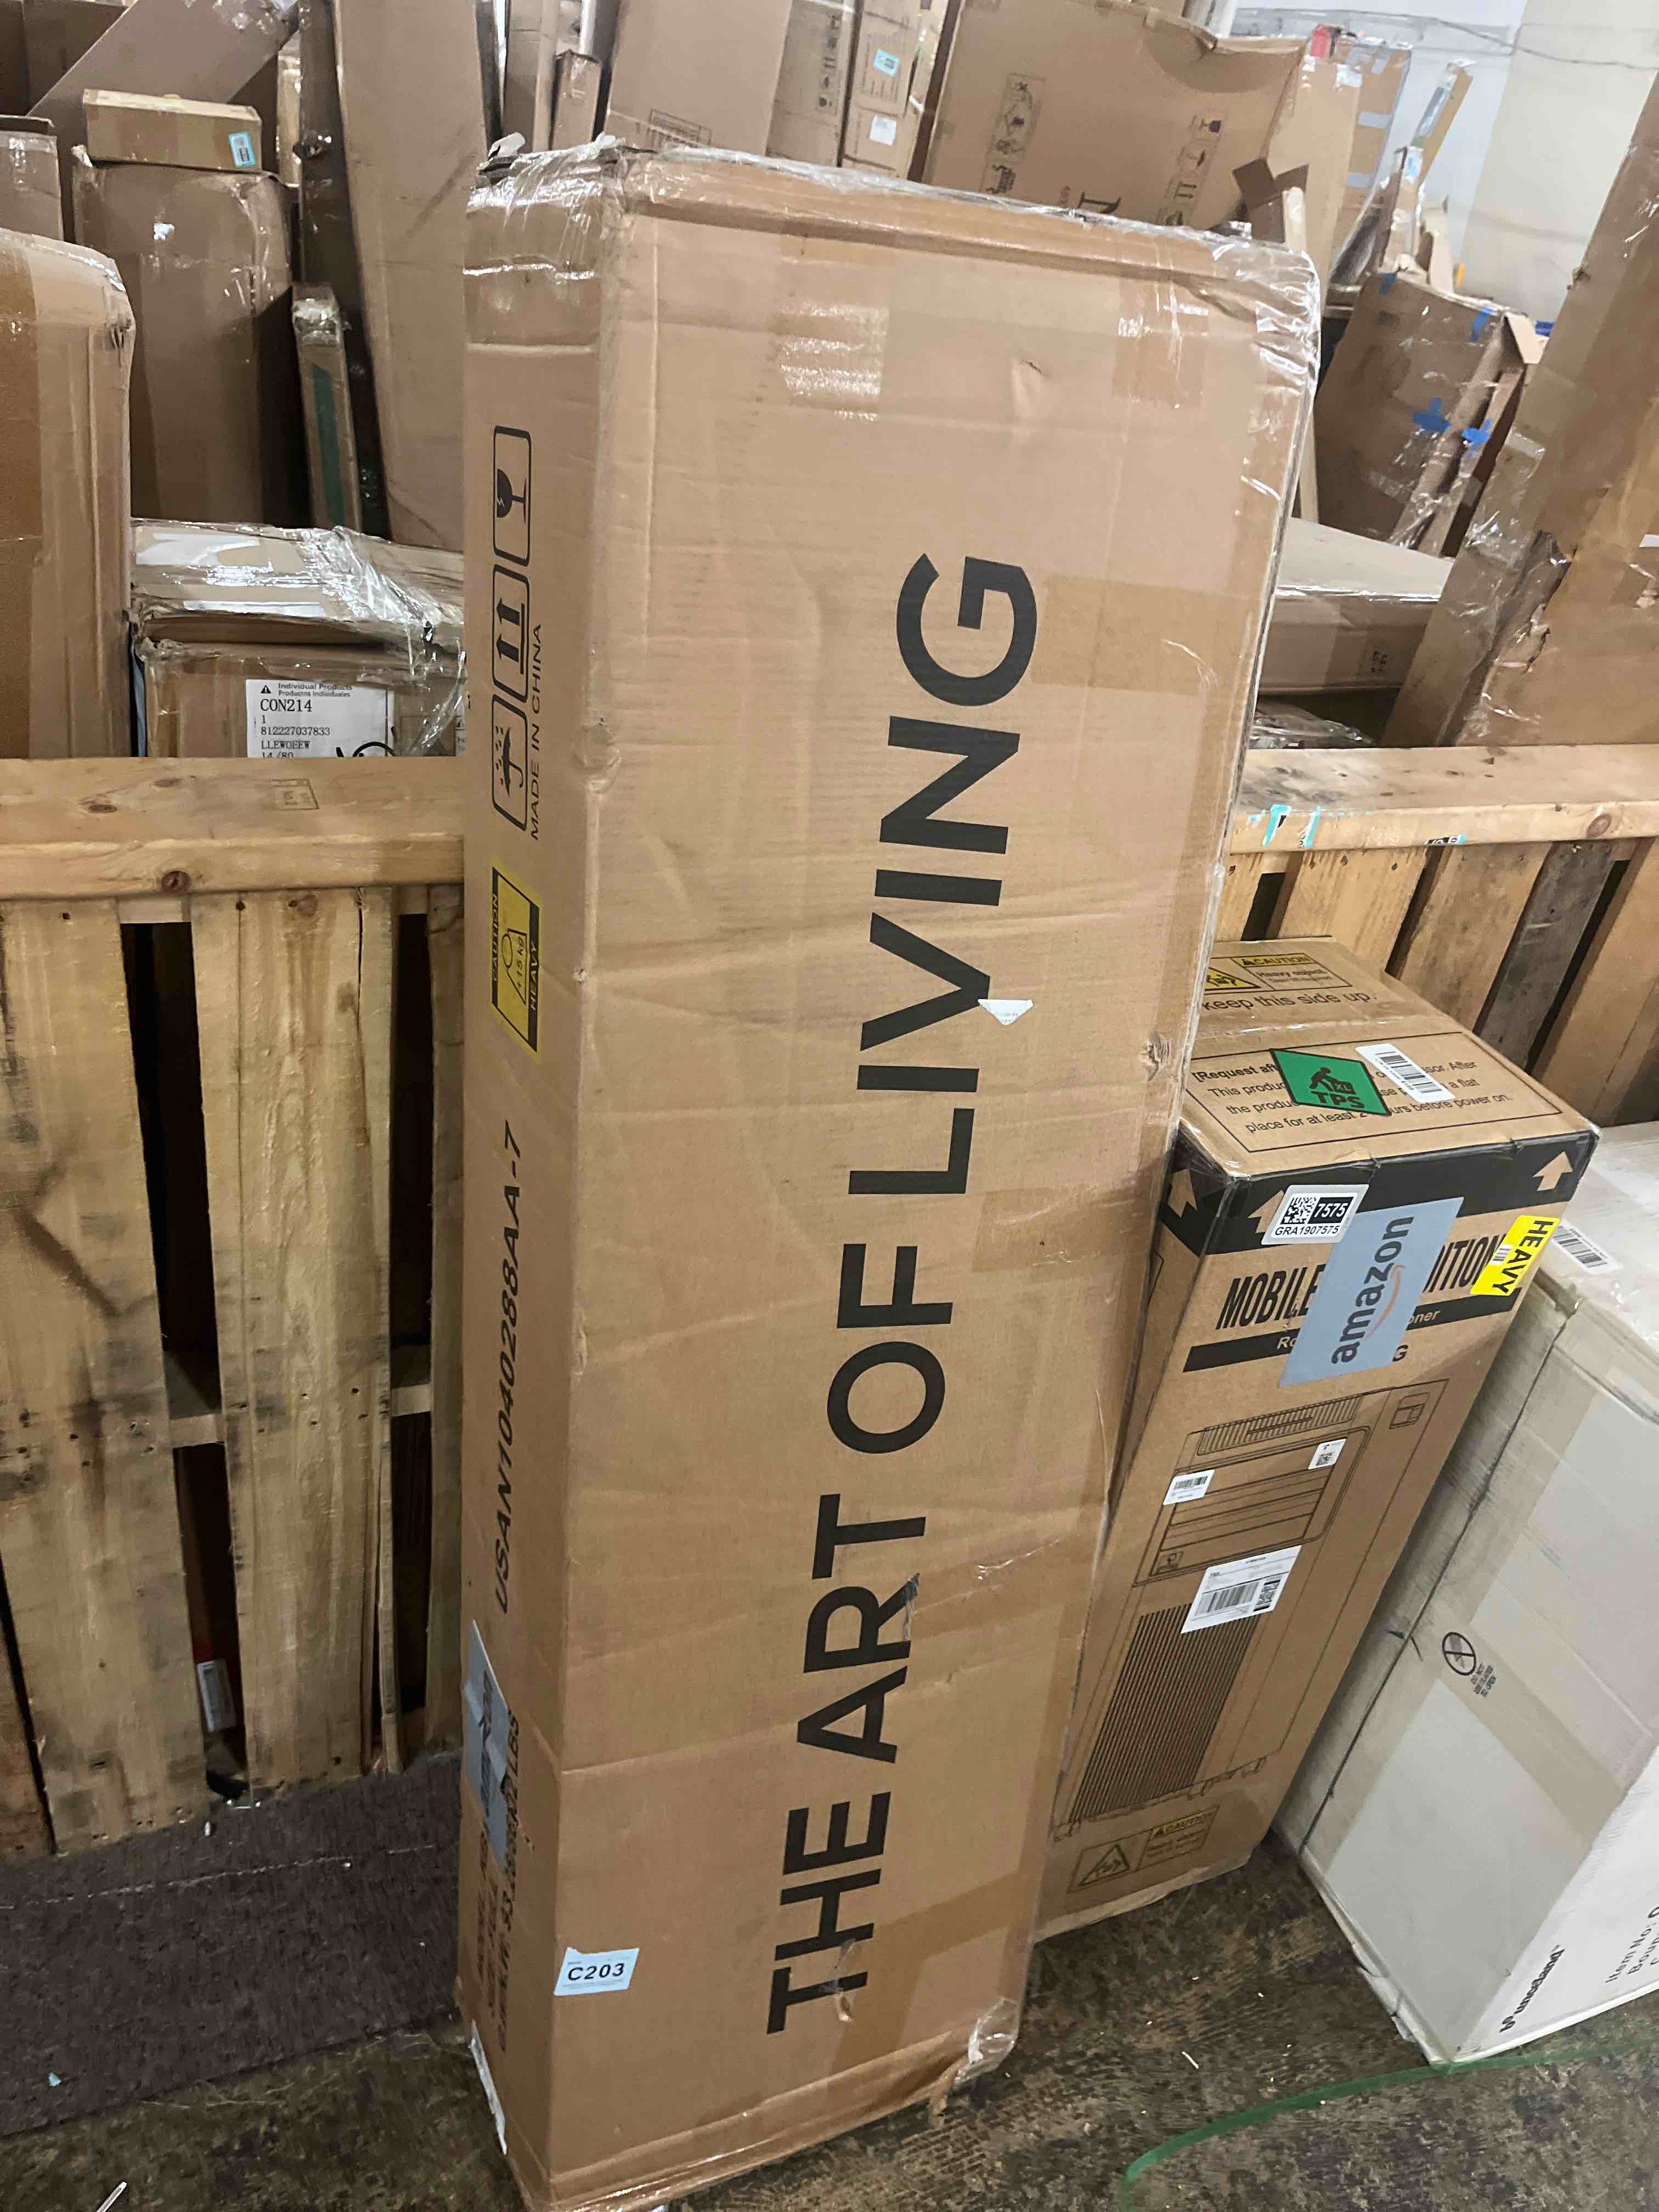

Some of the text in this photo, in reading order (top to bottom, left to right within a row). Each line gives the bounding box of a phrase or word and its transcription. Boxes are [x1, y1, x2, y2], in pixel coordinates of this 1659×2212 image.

[260, 698, 312, 713] CON214
[261, 715, 267, 724] 1
[261, 726, 330, 736] 812227037833
[530, 624, 542, 842] MADE IN CHINA
[1253, 956, 1312, 966] CAUTION
[530, 941, 539, 1011] HEAVY
[1254, 995, 1295, 1007] this
[1298, 993, 1341, 1005] side
[1259, 1063, 1278, 1073] aft
[1207, 1085, 1240, 1098] This
[1243, 1081, 1287, 1096] produc
[1226, 1099, 1293, 1115] the produ
[1311, 1091, 1365, 1108] TPS
[1245, 1119, 1284, 1134] place
[1284, 1116, 1304, 1128] for
[1306, 1115, 1323, 1124] at
[1319, 1110, 1357, 1122] least
[1410, 1098, 1453, 1112] before
[1454, 1095, 1492, 1109] power
[1314, 1203, 1348, 1218] 7575
[1275, 1224, 1340, 1235] GRA1907575
[1493, 1220, 1555, 1294] HEAVY
[766, 553, 1037, 2036] THE ART OF LIVING
[1215, 1263, 1327, 1330] MOBILE
[1330, 1216, 1414, 1365] amazon
[494, 1119, 522, 1615] USAN1040288AA-7
[568, 1962, 624, 1981] C203
[1605, 1950, 1636, 1983] Item
